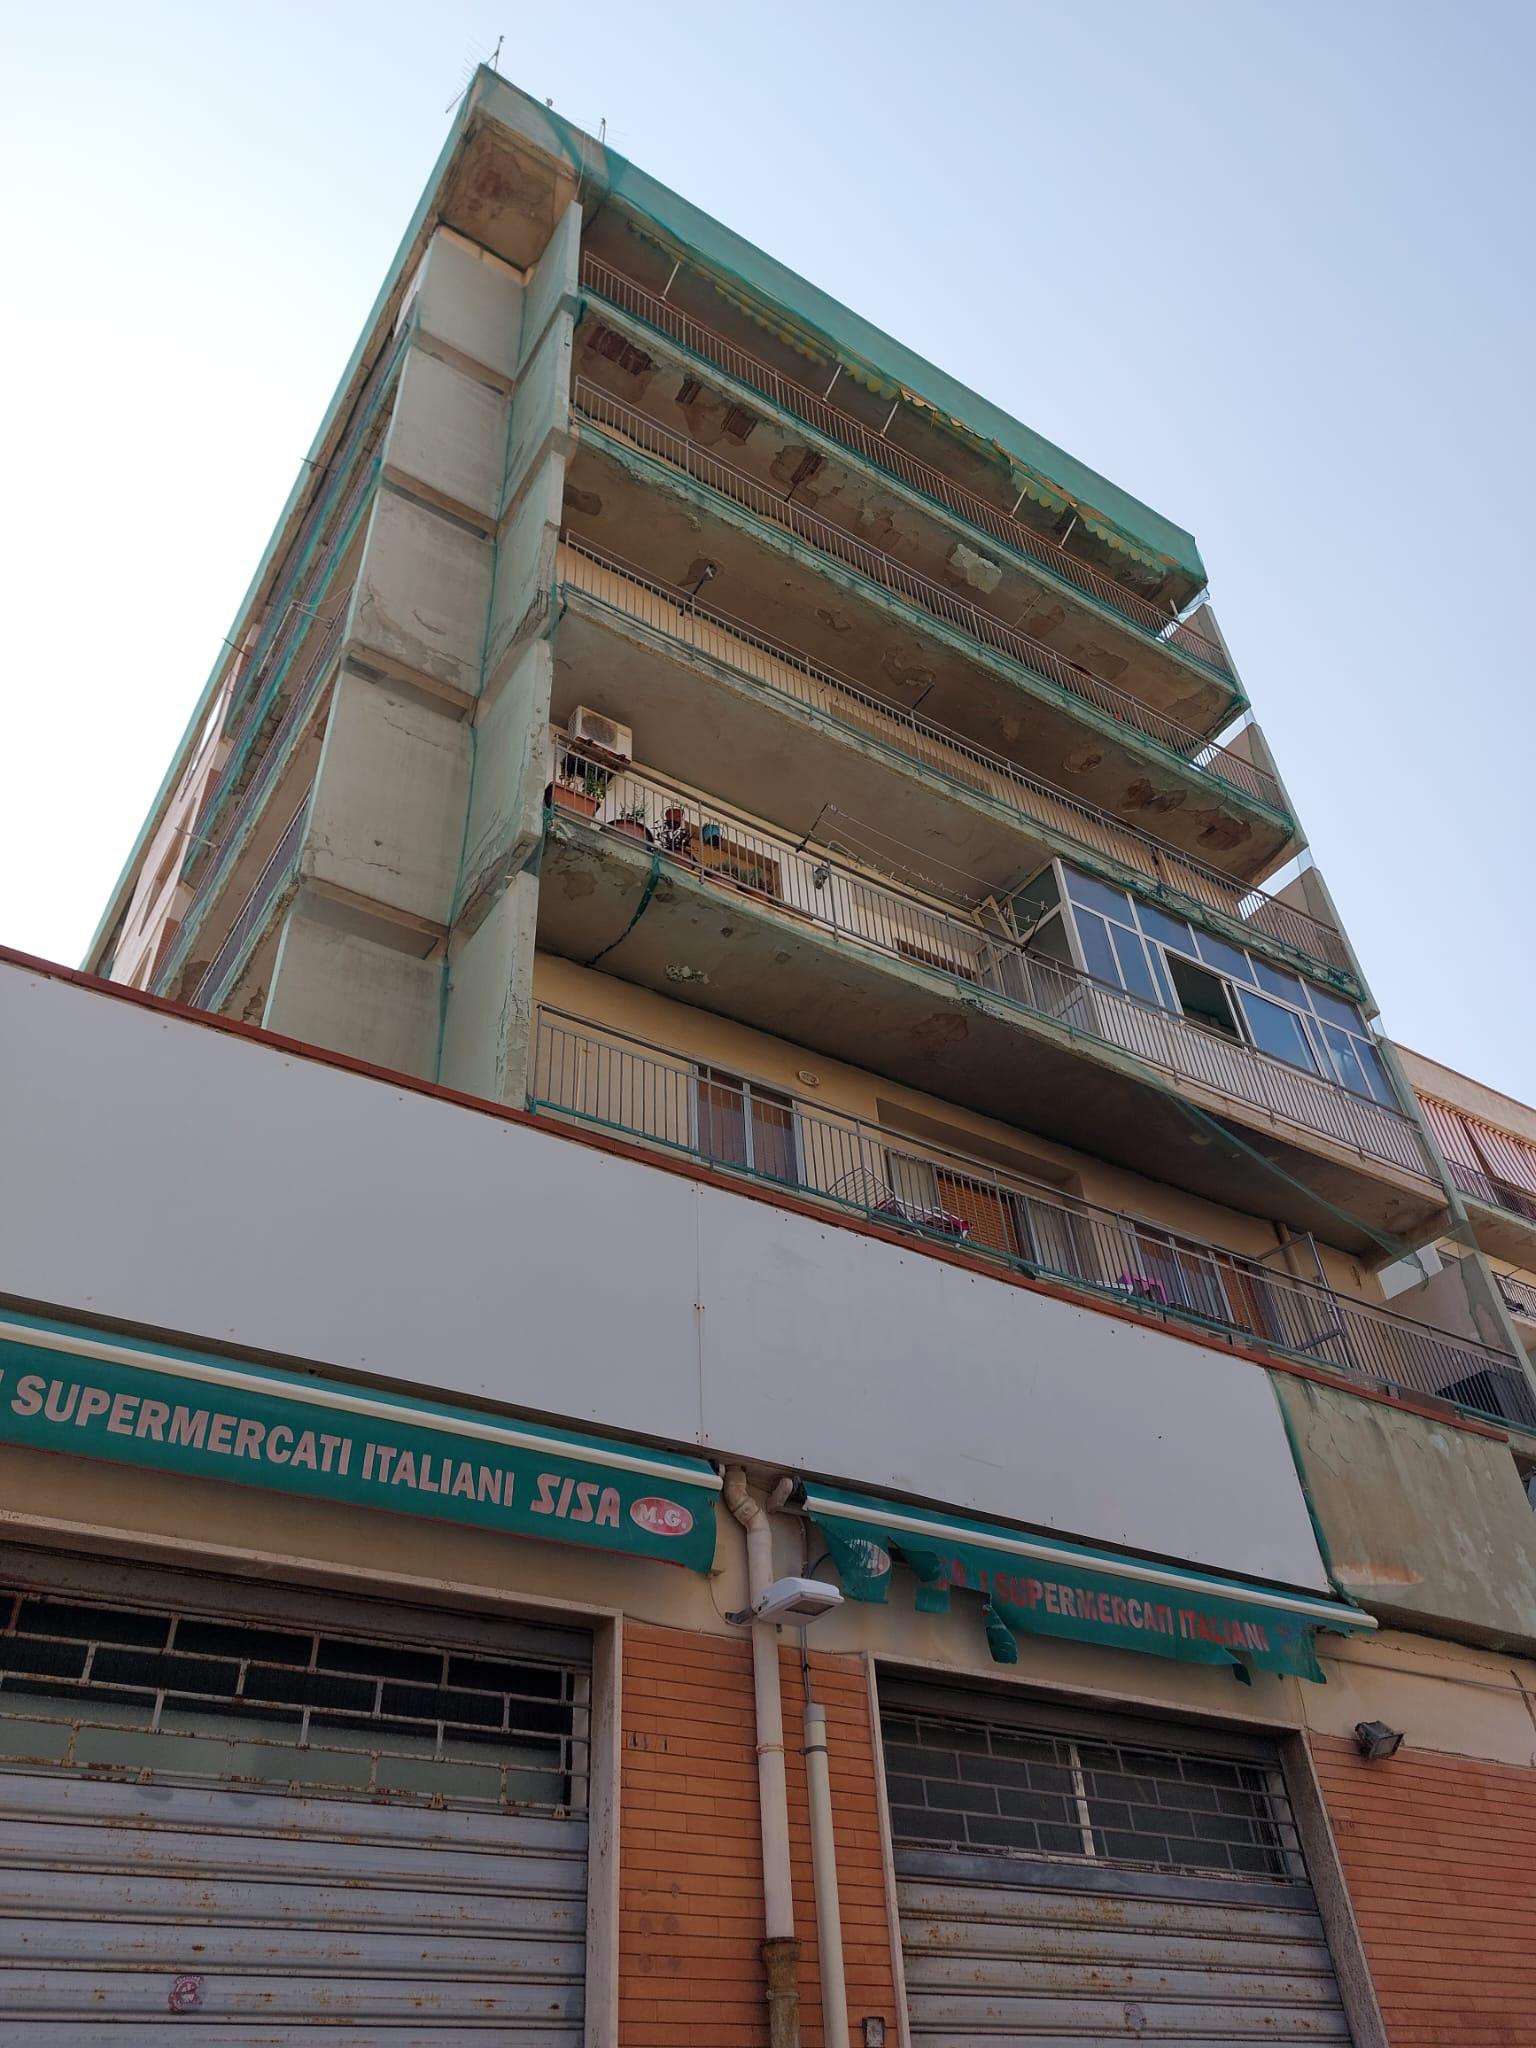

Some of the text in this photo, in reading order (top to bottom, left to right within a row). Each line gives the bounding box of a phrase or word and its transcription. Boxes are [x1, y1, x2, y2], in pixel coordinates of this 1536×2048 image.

[10, 1374, 620, 1528] SUPERMERCATI ITALIANI SISA
[638, 1503, 687, 1528] M.G.
[994, 1572, 1174, 1636] SUPERMERCATI
[1178, 1607, 1270, 1652] ITALIANI
